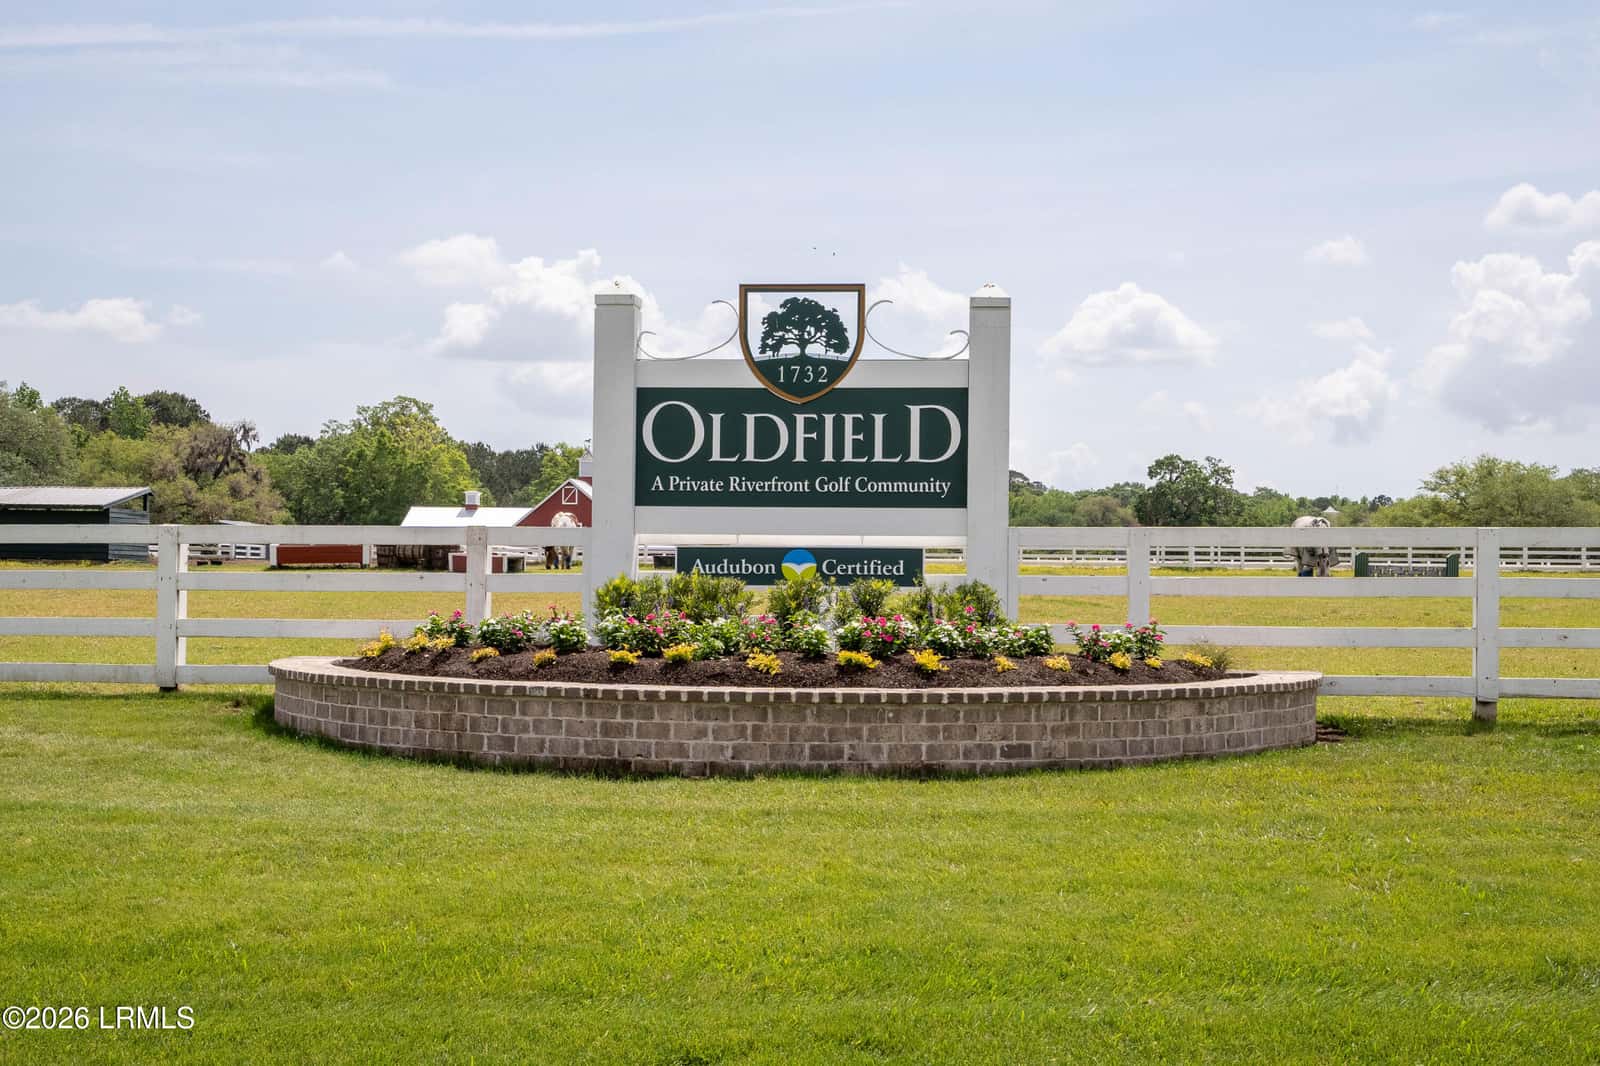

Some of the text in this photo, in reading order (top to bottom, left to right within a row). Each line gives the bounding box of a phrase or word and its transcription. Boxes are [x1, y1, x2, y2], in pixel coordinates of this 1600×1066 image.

[778, 365, 829, 384] 1732
[642, 400, 962, 463] OLDFIELD
[651, 476, 951, 498] A Private Riverfront Golf Community
[692, 558, 905, 576] Audubon Certified
